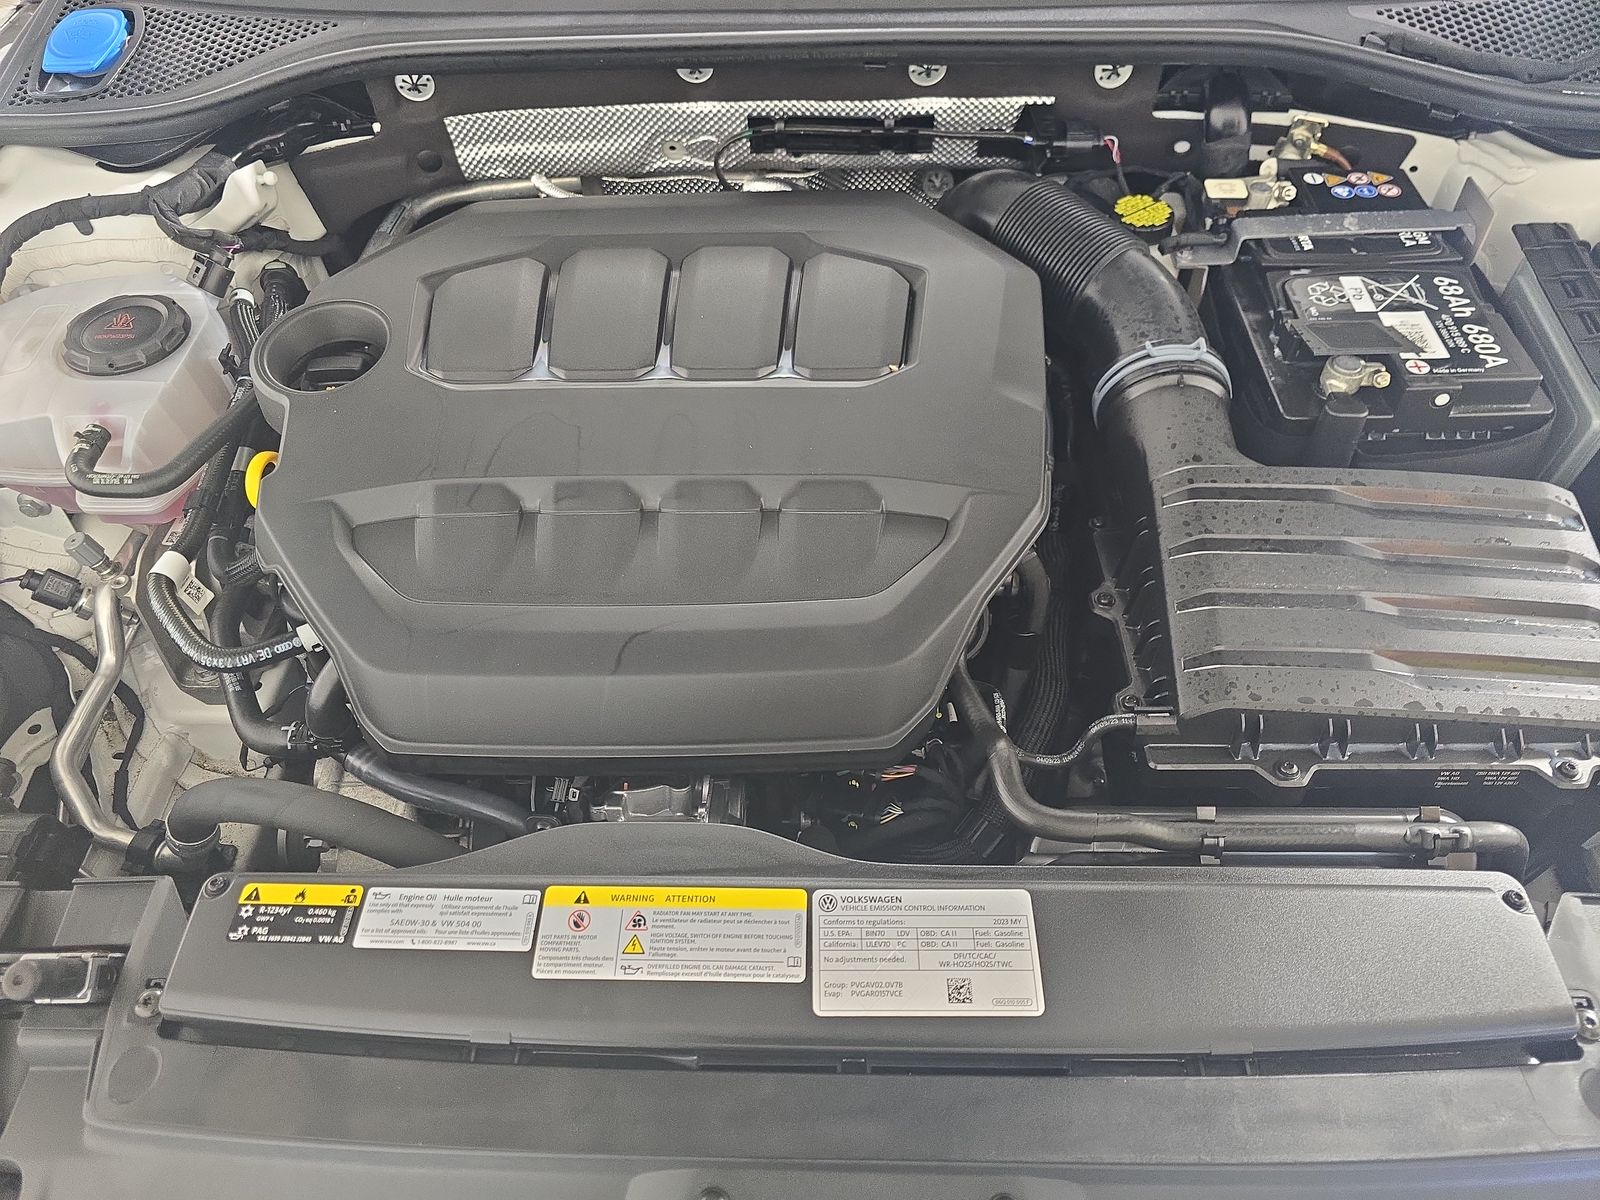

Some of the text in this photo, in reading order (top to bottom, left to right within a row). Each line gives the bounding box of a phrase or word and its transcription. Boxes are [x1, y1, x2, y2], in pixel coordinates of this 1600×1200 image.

[1348, 288, 1363, 300] Pb
[1433, 277, 1476, 317] 68Ah
[1462, 324, 1508, 368] 680A
[256, 648, 272, 660] DE
[236, 656, 255, 667] VRT
[399, 894, 424, 902] Engine
[611, 894, 716, 903] WARNING ATTENTION
[259, 906, 293, 916] R-1234yf
[327, 908, 337, 917] kg
[866, 918, 906, 927] regulations:
[251, 927, 269, 935] PAG
[835, 956, 878, 965] adjustments
[824, 982, 848, 990] Group:
